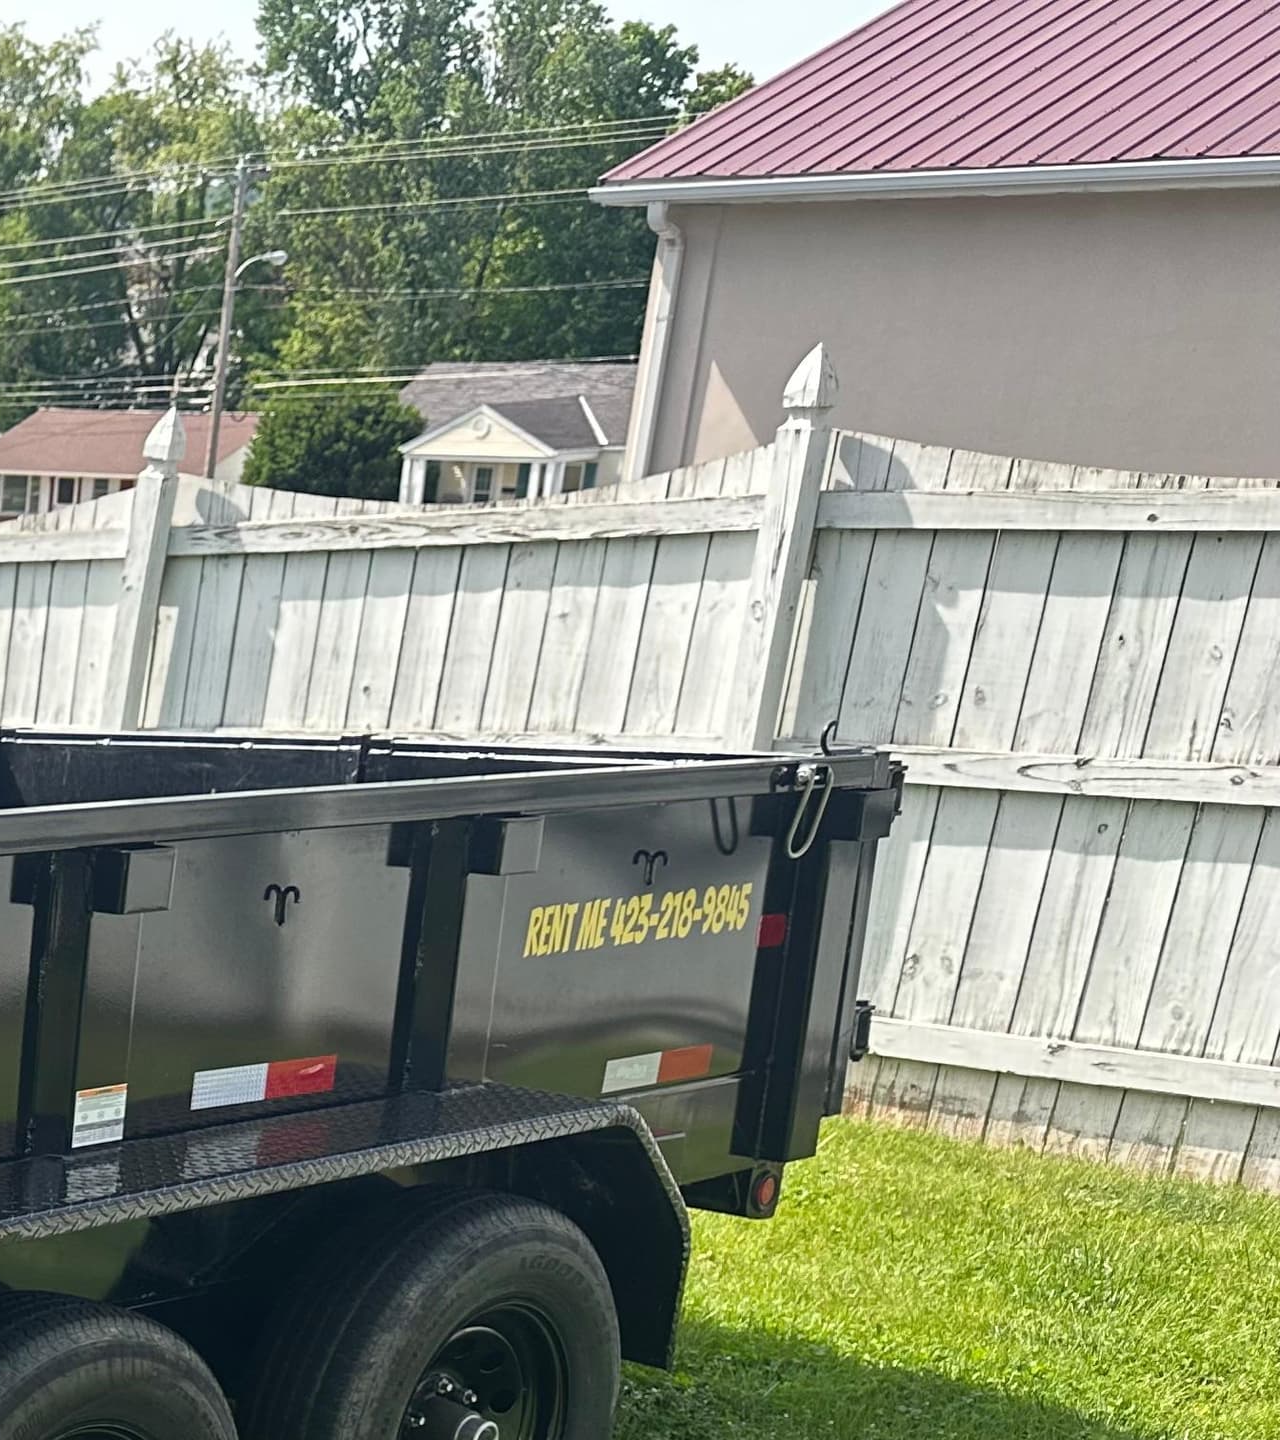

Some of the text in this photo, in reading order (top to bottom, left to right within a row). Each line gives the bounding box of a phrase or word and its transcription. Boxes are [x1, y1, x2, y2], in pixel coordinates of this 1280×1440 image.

[523, 883, 753, 958] RENT ME 423-218-9845
